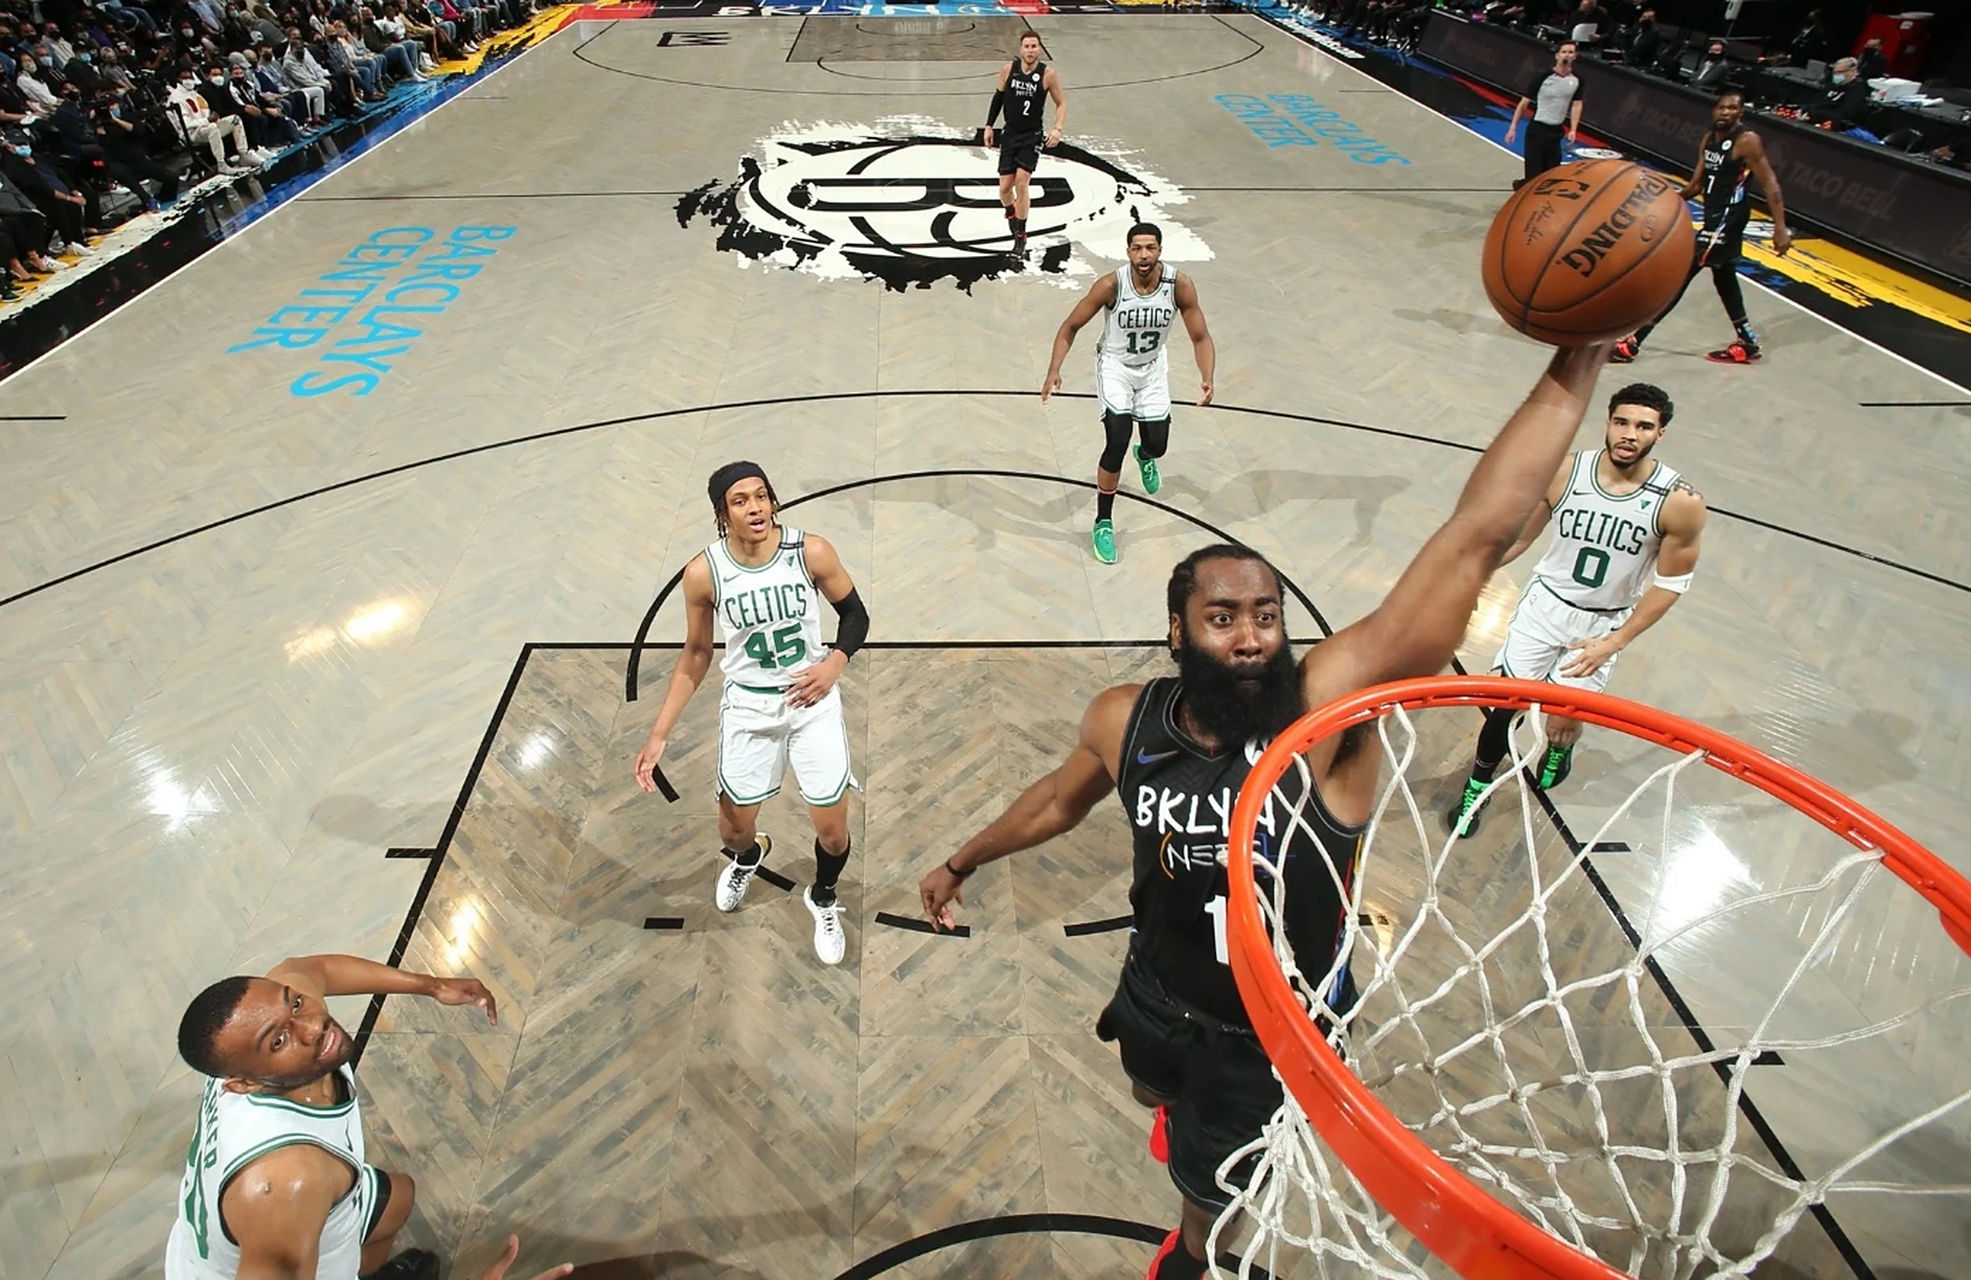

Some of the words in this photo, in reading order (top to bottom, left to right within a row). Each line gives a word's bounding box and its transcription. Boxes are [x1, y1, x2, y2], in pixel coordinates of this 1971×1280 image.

[1023, 100, 1031, 116] 2
[1213, 93, 1318, 148] CENTER
[1265, 93, 1412, 166] BARCLAYS
[1787, 161, 1843, 198] TACO
[225, 226, 435, 354] CENTER
[290, 225, 520, 398] BARCLAYS
[1118, 307, 1172, 329] CELTICS
[1126, 331, 1161, 354] 13
[1559, 508, 1647, 556] CELTICS
[1571, 546, 1611, 588] 0
[724, 583, 807, 630] CELTICS
[744, 622, 806, 669] 45
